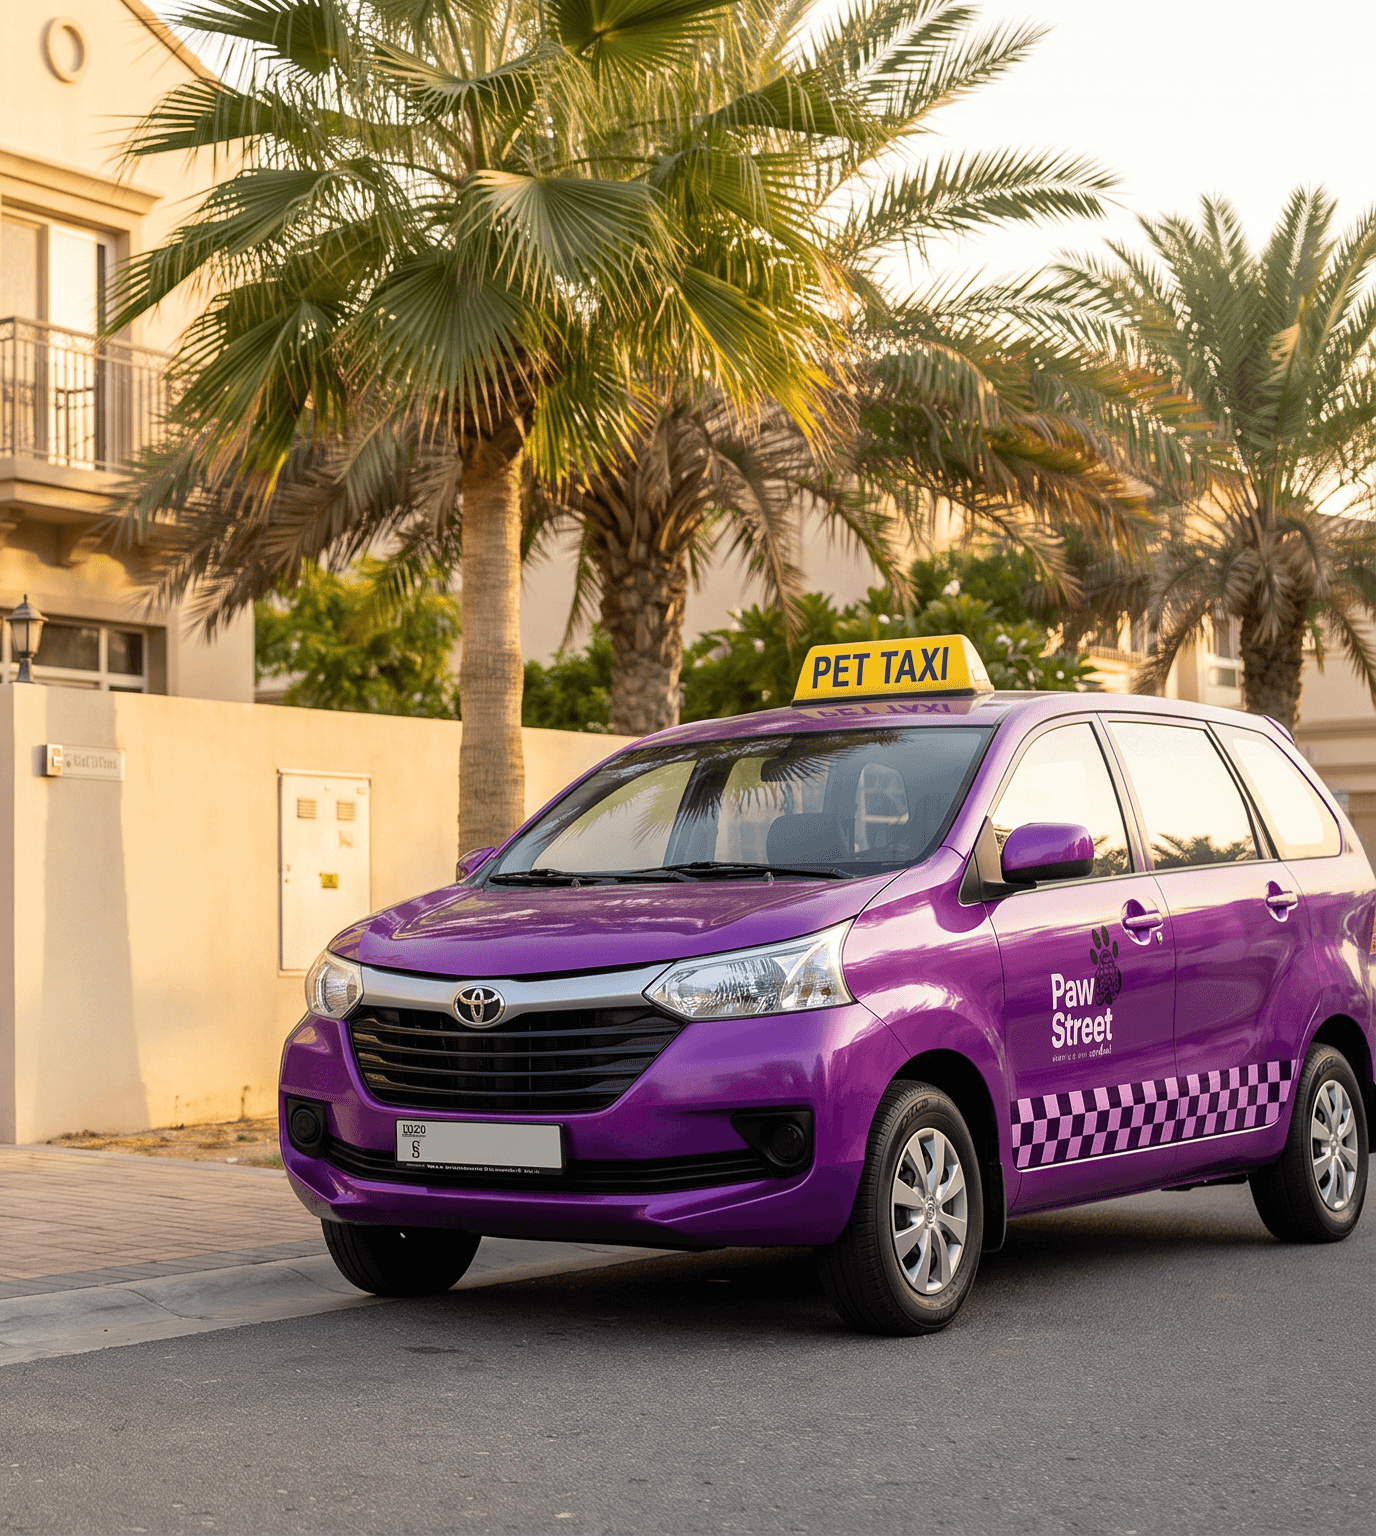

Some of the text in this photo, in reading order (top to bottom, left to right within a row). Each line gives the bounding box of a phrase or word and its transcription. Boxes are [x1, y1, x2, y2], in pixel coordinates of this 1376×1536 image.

[812, 646, 949, 689] PET TAXI
[1050, 973, 1095, 1010] Paw
[1051, 1008, 1113, 1049] Street
